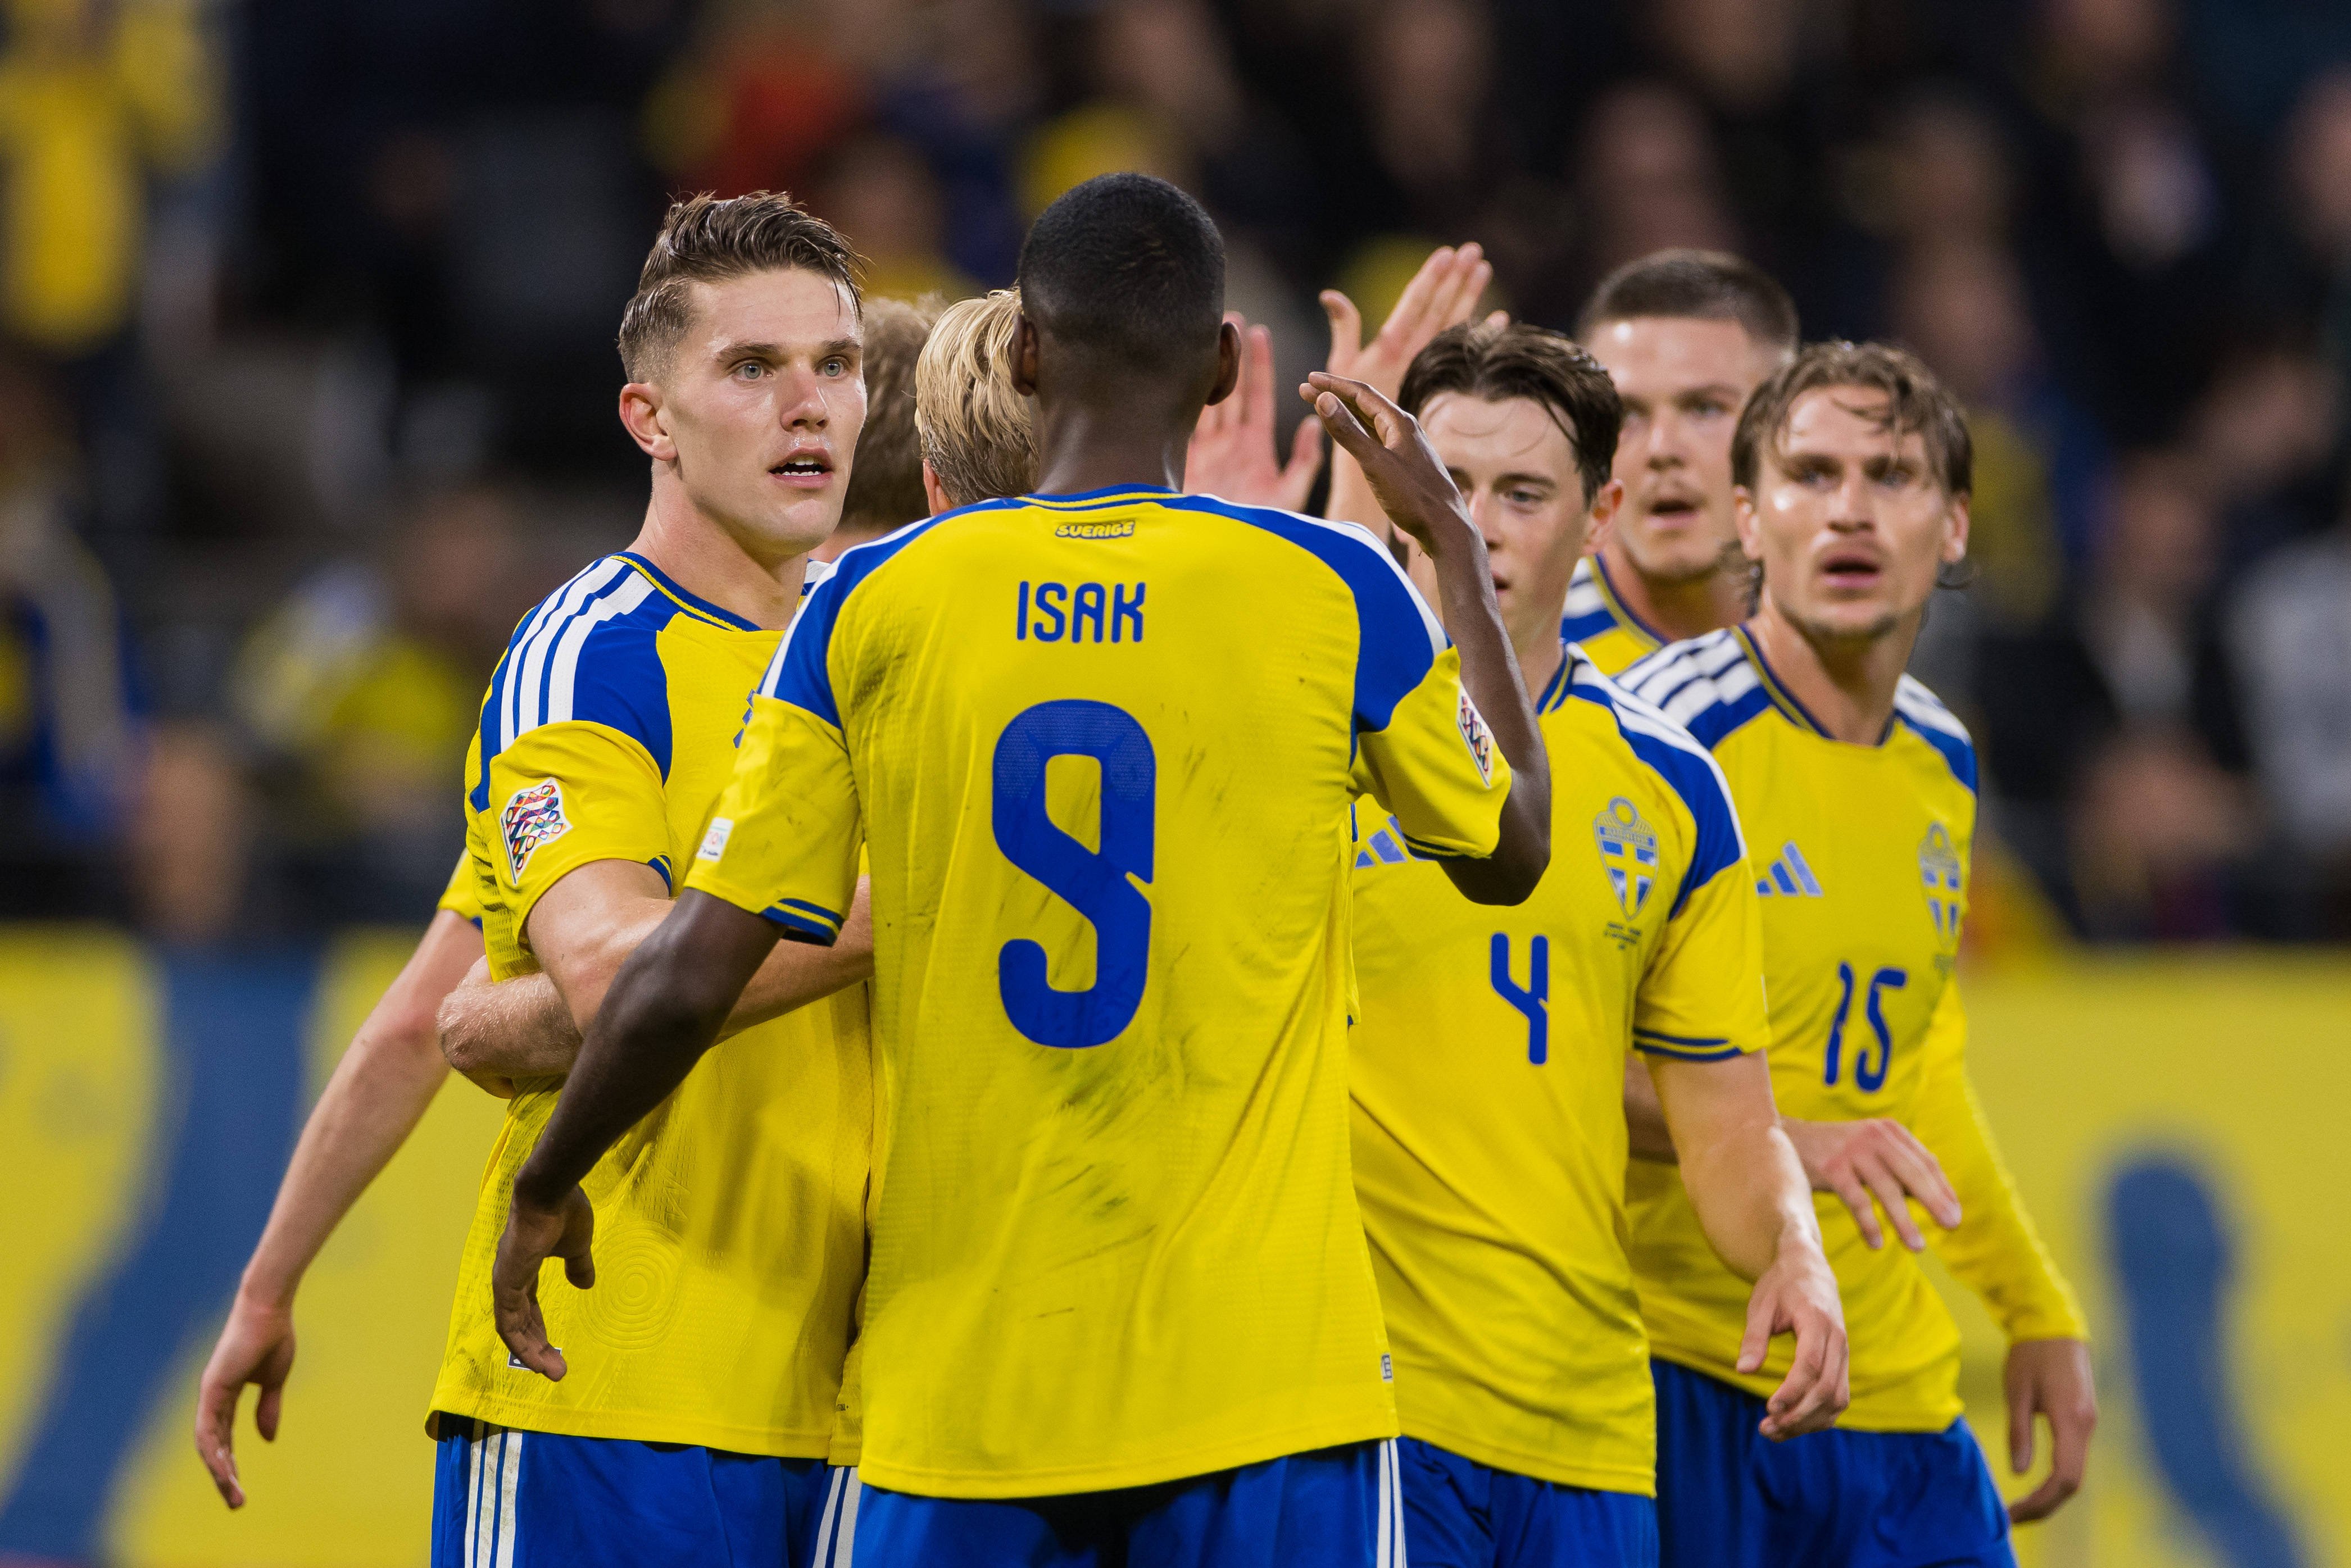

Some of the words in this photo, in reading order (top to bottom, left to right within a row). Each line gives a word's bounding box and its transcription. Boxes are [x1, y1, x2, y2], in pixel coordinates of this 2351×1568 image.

[1055, 520, 1135, 539] SVERIGE
[1016, 580, 1146, 643] ISAK
[992, 698, 1156, 1048] 9
[1490, 931, 1549, 1066] 4
[1824, 961, 1907, 1092] 15
